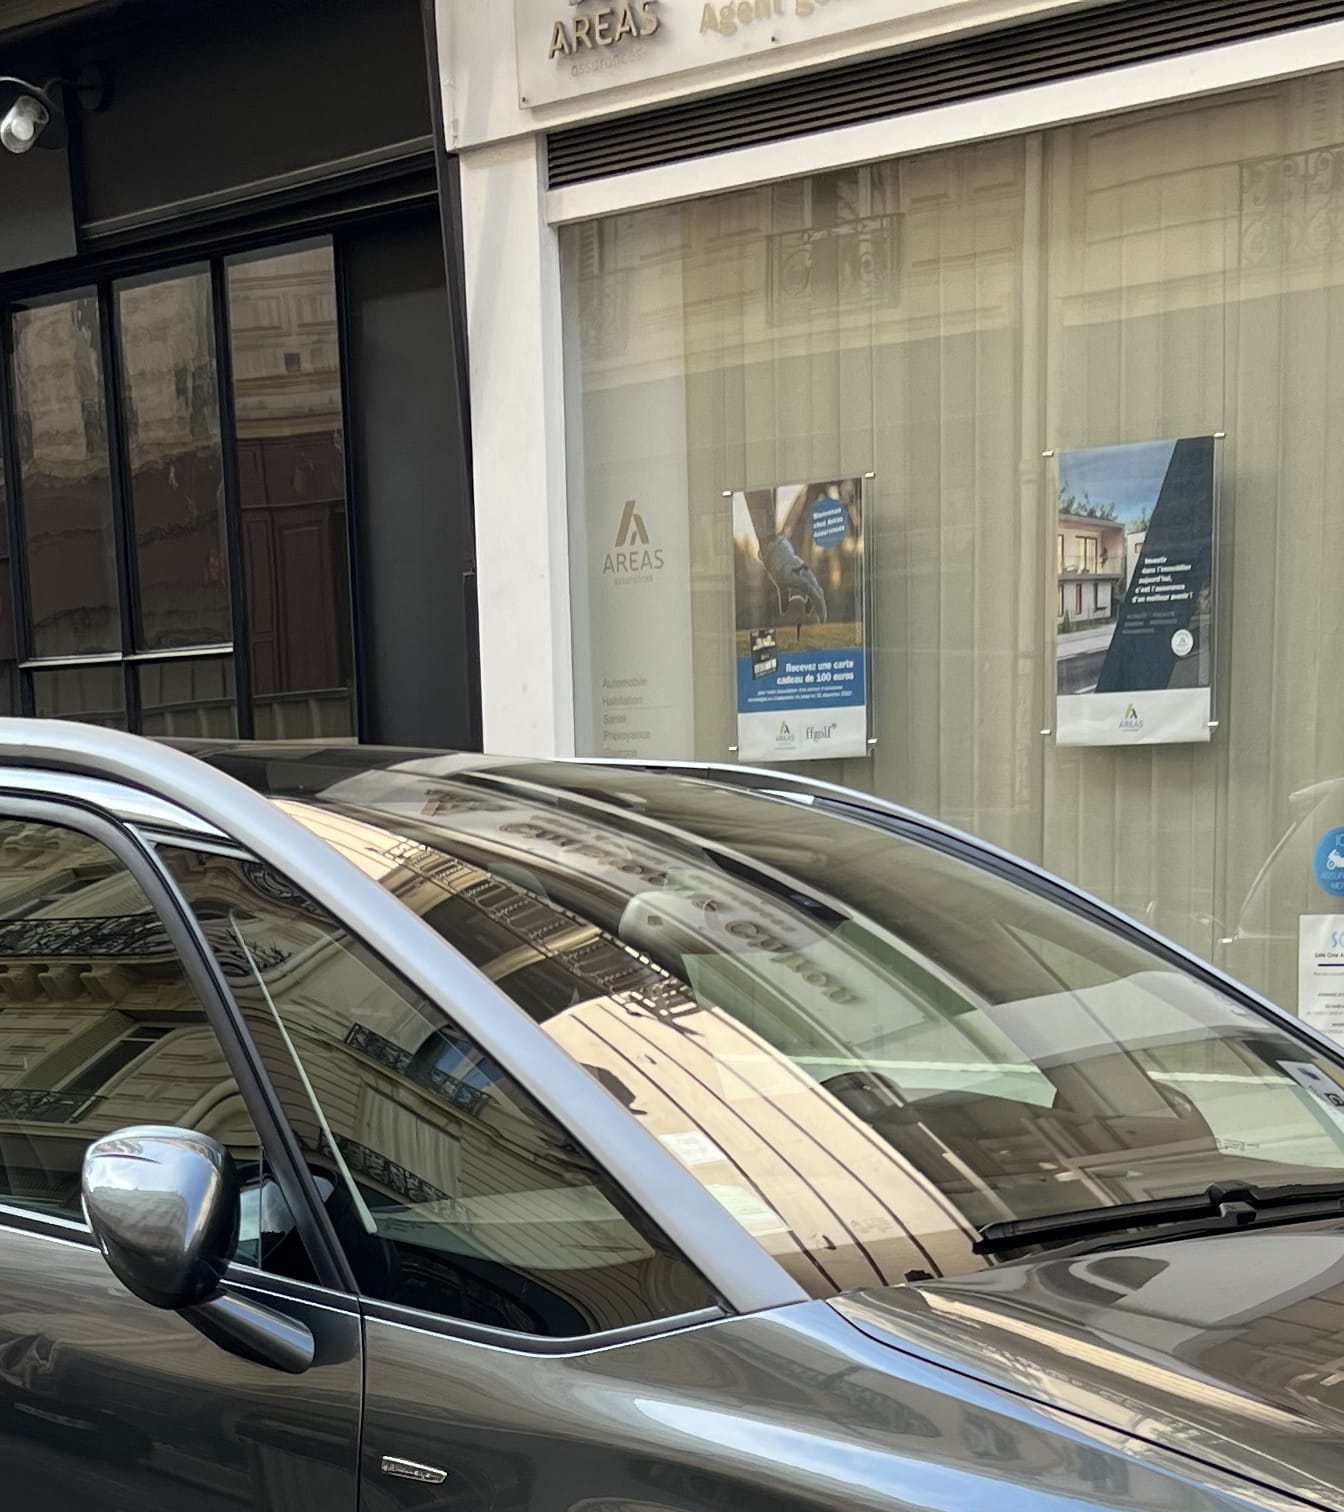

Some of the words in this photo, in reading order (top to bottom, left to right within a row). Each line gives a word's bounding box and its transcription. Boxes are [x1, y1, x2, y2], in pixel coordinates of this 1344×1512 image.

[548, 0, 660, 59] AREAS
[602, 548, 665, 575] AREAS
[816, 672, 832, 682] 100
